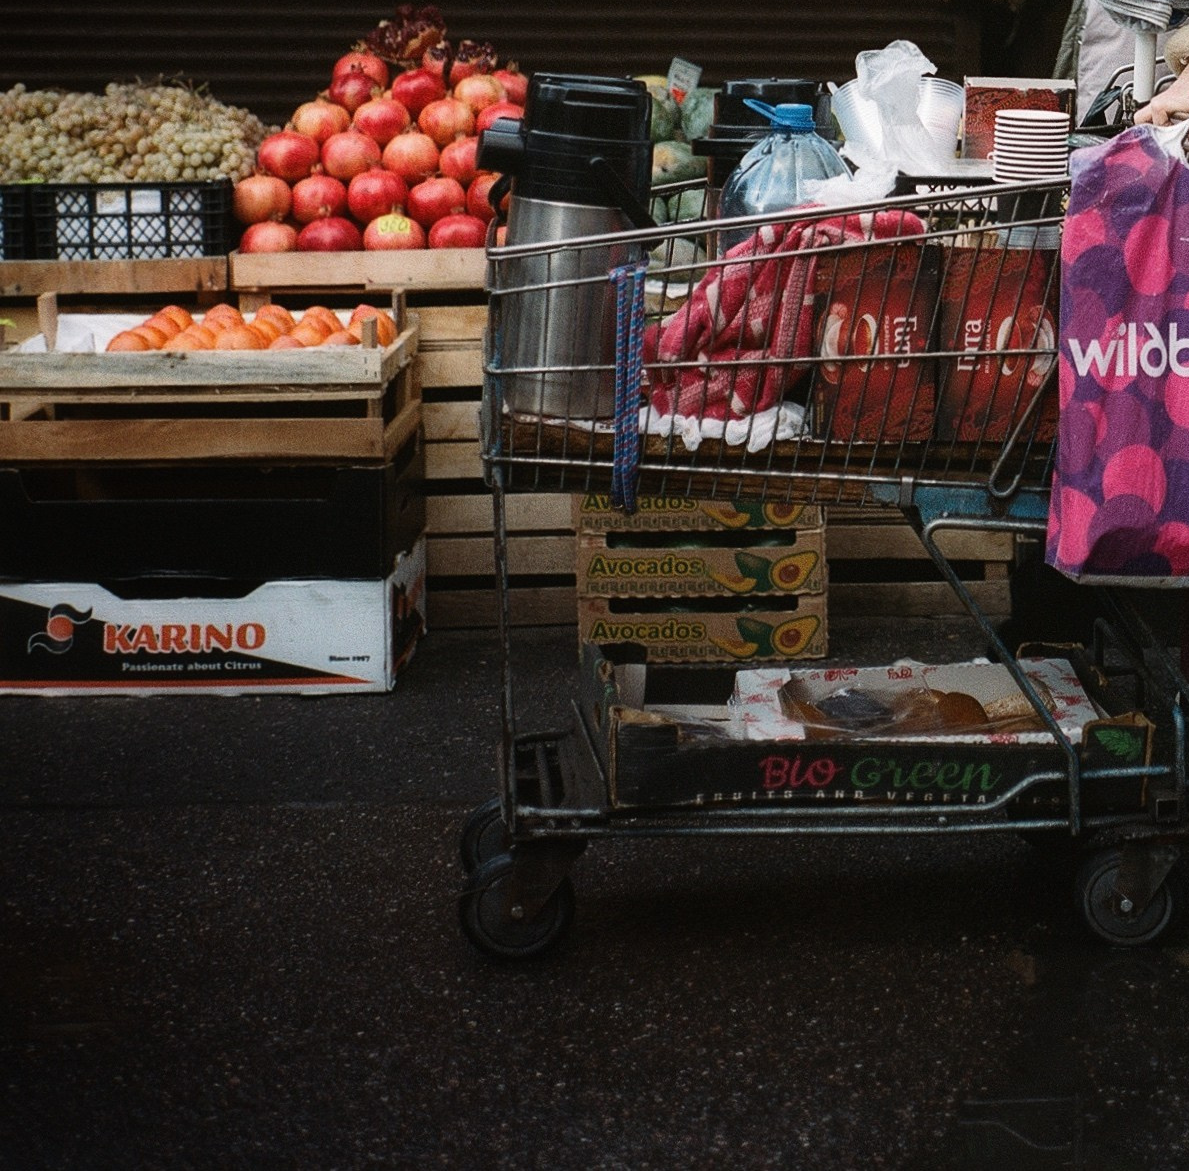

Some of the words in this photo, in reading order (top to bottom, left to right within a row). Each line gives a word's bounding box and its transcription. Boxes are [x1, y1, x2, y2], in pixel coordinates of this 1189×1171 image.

[582, 493, 699, 513] Avados
[589, 555, 705, 578] Avocados
[104, 622, 266, 653] KARINO
[591, 619, 706, 642] Avocados
[122, 662, 184, 672] Passionate
[187, 661, 221, 671] about
[224, 660, 262, 670] Citrus
[851, 757, 1002, 791] Green
[696, 790, 793, 806] FRUITS
[816, 790, 865, 800] AND
